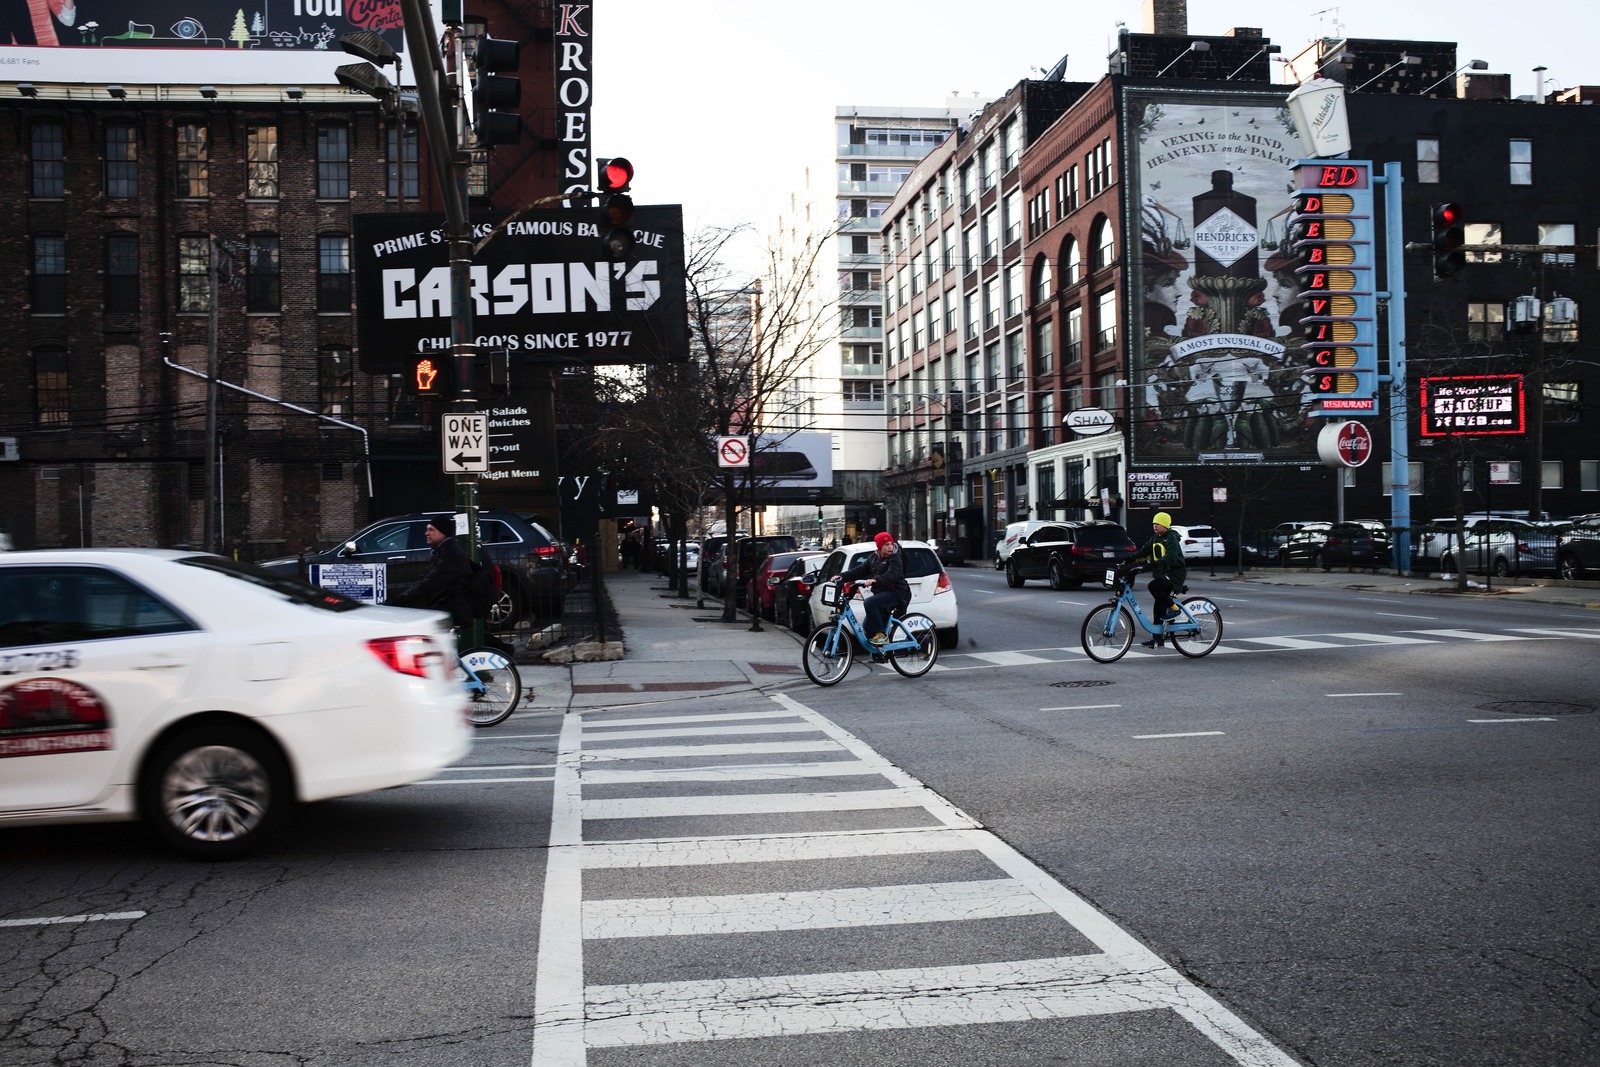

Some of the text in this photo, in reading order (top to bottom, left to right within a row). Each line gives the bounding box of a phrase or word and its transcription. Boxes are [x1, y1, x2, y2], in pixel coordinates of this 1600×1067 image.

[1161, 131, 1215, 148] VEXING
[1229, 133, 1241, 141] the
[1244, 133, 1285, 152] MIND,
[1146, 143, 1218, 169] HEAVENLY
[1235, 145, 1247, 155] the
[1319, 166, 1358, 186] ED
[373, 221, 665, 258] PRIME SKS FAMOUS BACUE
[1196, 232, 1256, 242] HENDRICK'S
[382, 260, 661, 319] CARSON'S
[418, 331, 632, 353] CHIGO'S SINCE 1977
[1180, 337, 1283, 354] A MOST UNUSUAL GIN
[492, 407, 528, 416] Salads
[1323, 400, 1373, 409] RESTAURANT
[449, 419, 482, 433] ONE
[1074, 415, 1108, 426] SHAY
[448, 435, 483, 449] WAY
[482, 470, 510, 480] Night
[511, 469, 540, 478] Menu
